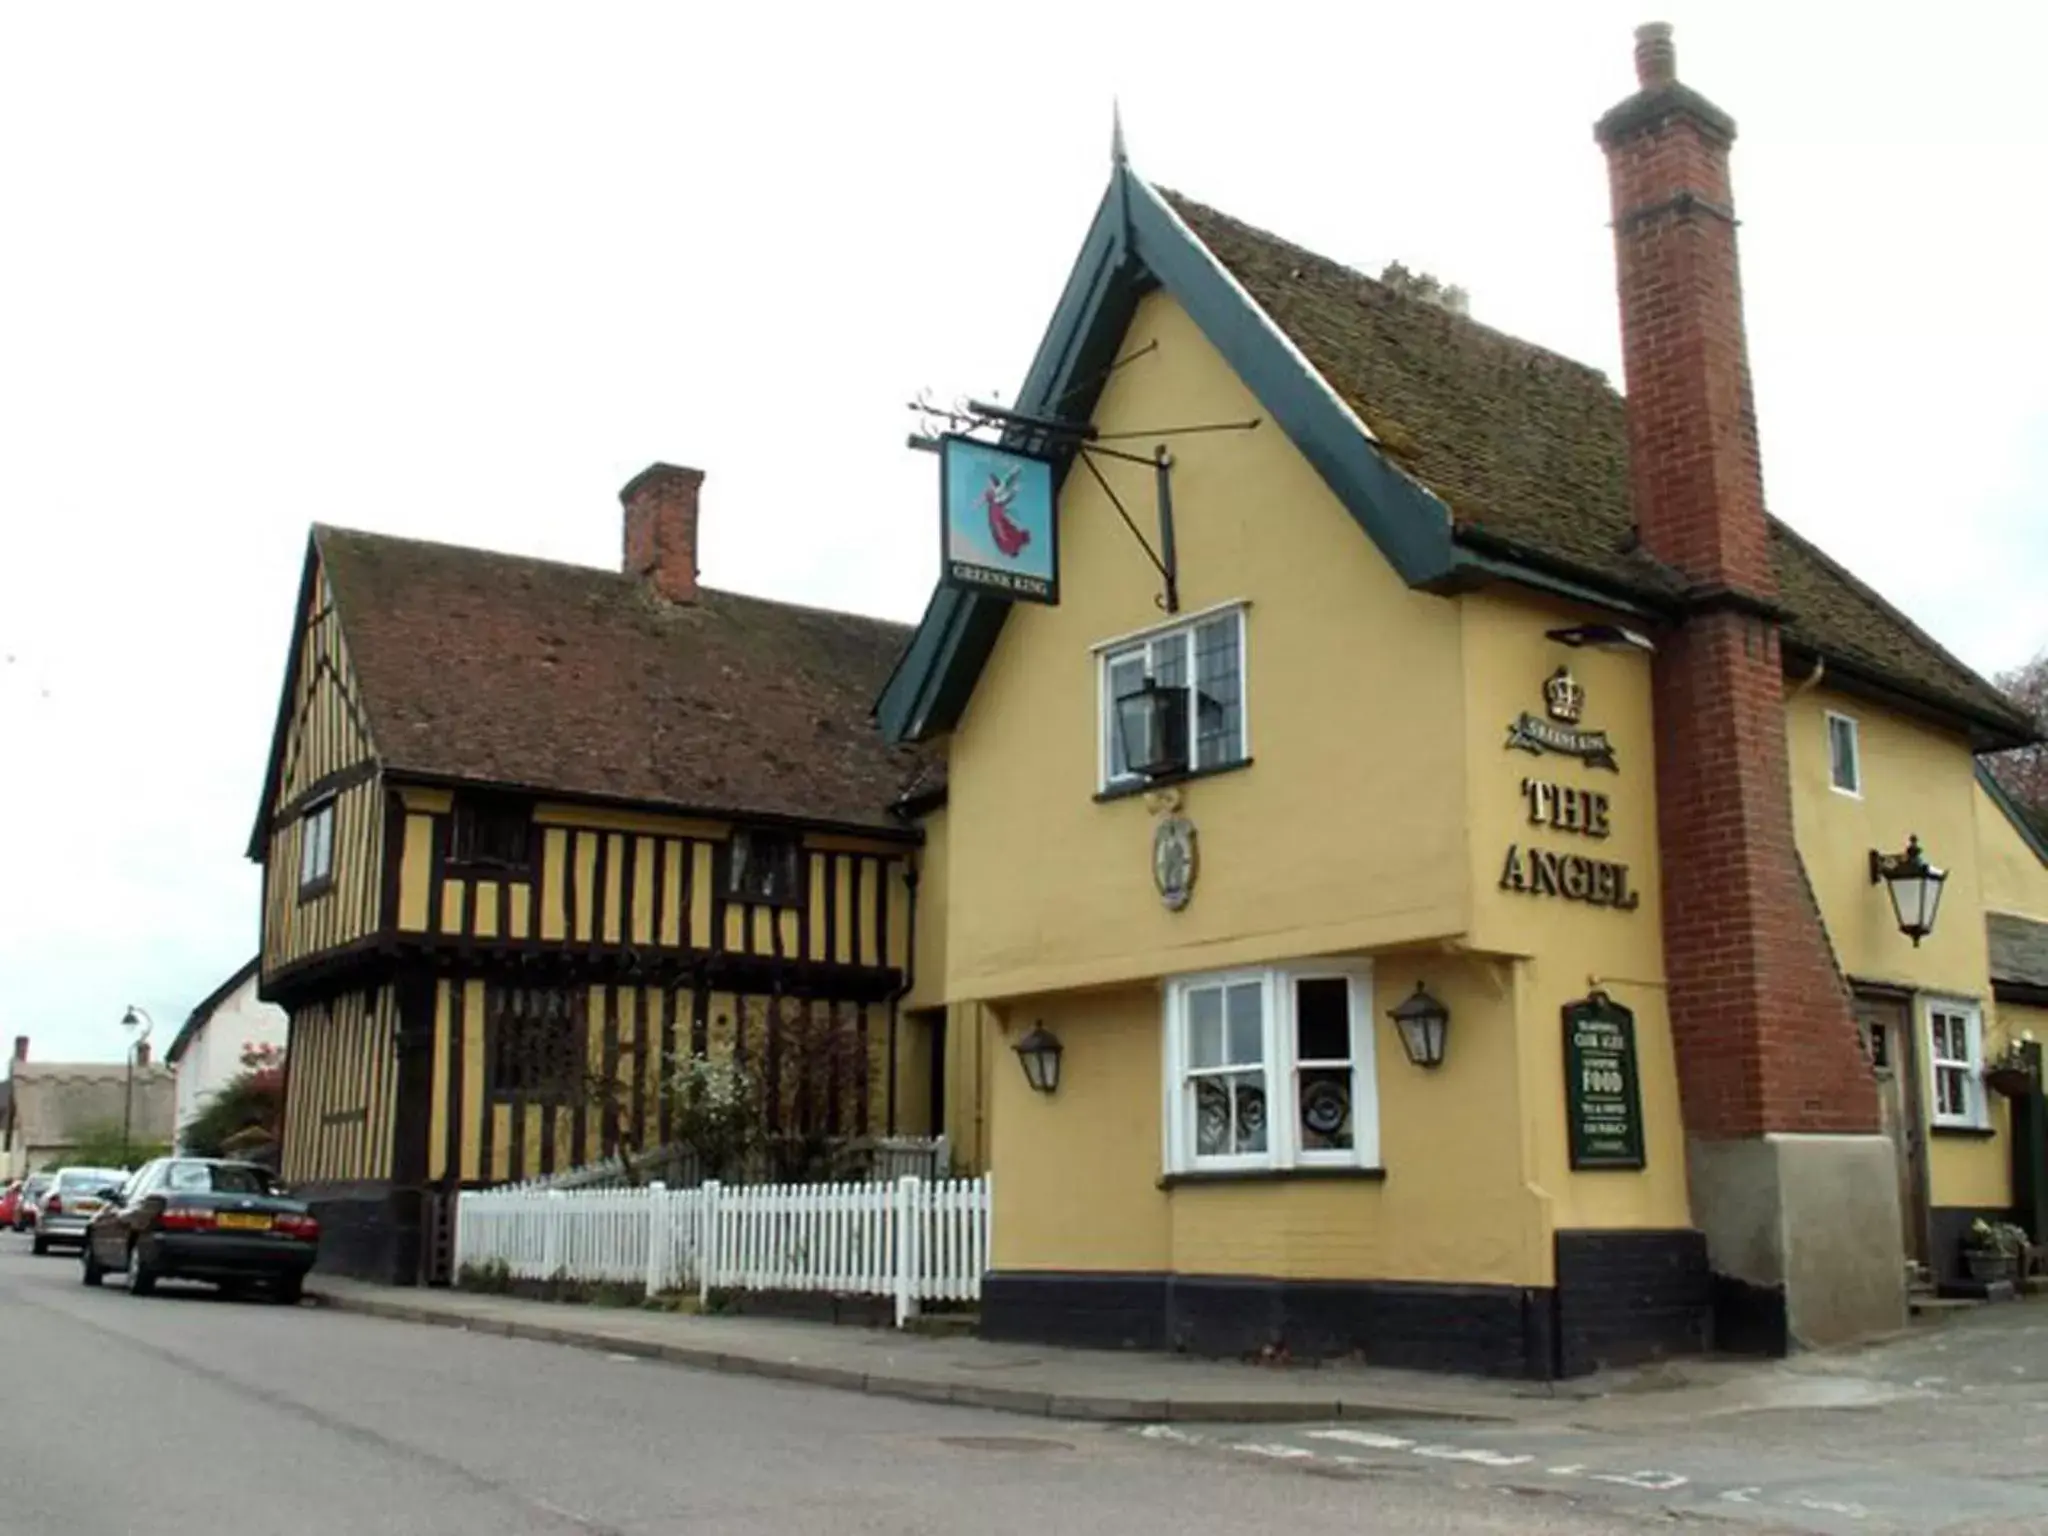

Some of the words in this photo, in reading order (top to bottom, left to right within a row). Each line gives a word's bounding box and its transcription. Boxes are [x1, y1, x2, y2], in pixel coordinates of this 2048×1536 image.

[1522, 777, 1610, 838] THE
[1499, 844, 1639, 910] ANGEL
[1582, 1069, 1623, 1093] FOOD
